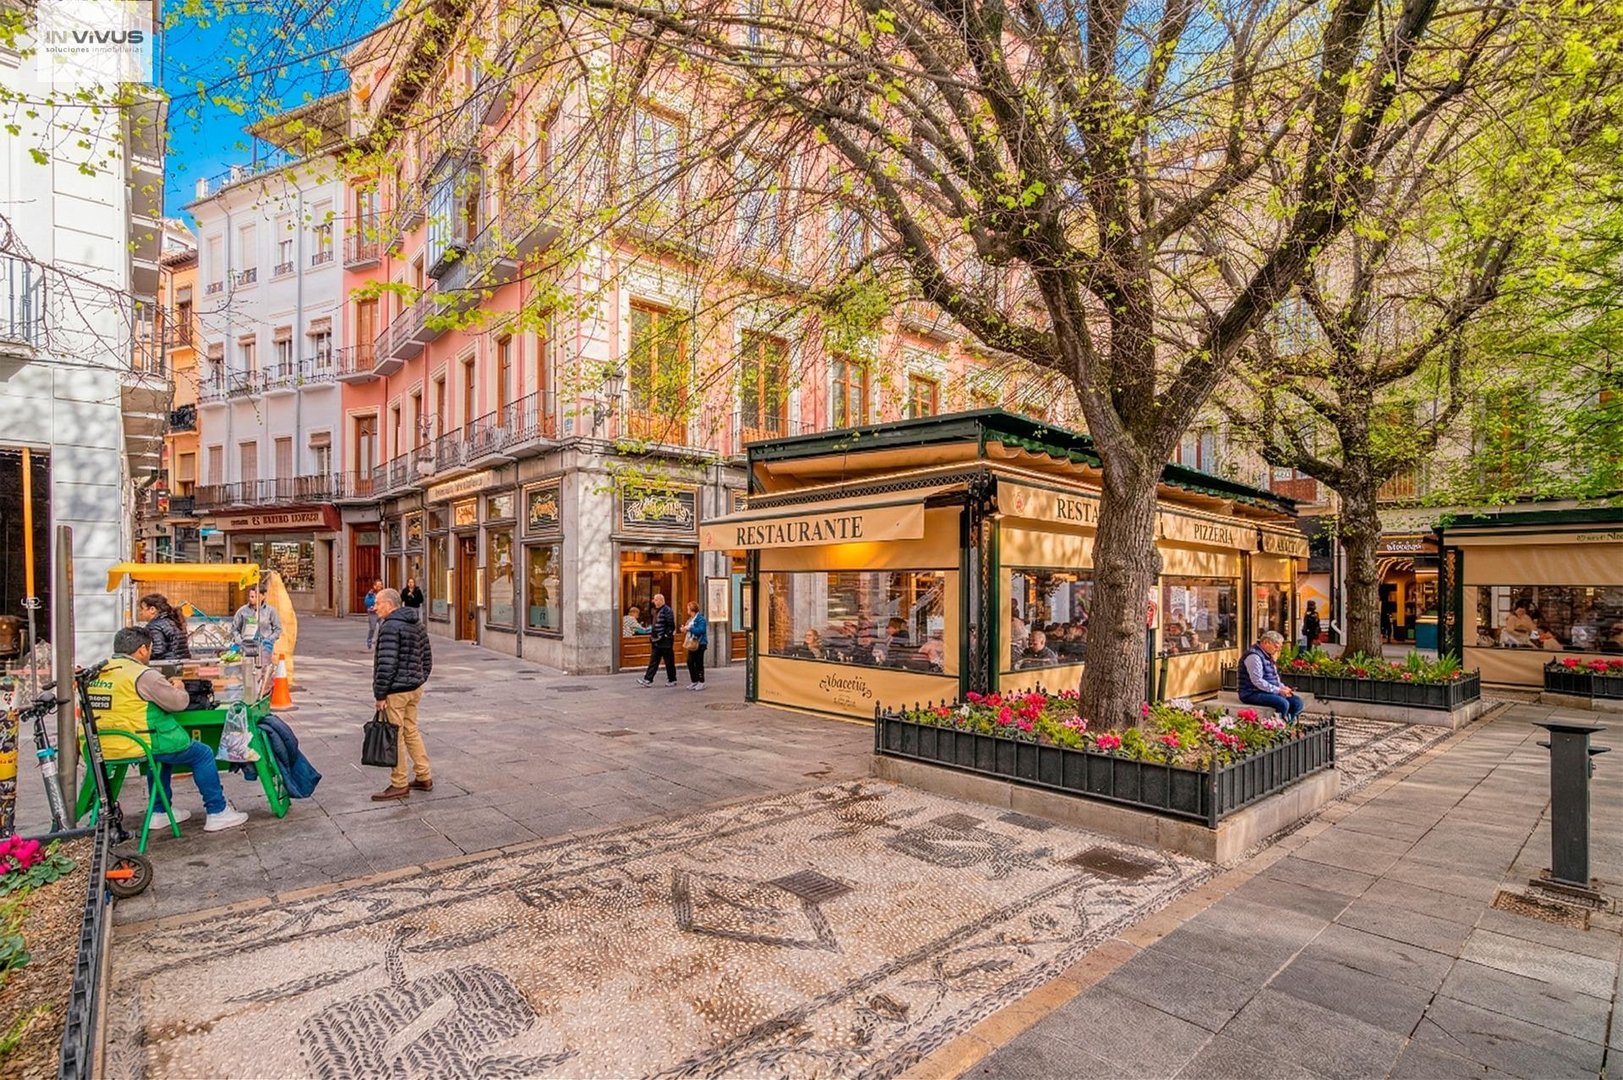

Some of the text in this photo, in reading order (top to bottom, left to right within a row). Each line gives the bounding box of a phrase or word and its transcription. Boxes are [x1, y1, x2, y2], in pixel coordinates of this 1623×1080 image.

[1056, 497, 1099, 523] RESTA
[736, 516, 863, 546] RESTAURANTE
[1194, 523, 1233, 545] PIZZERIA
